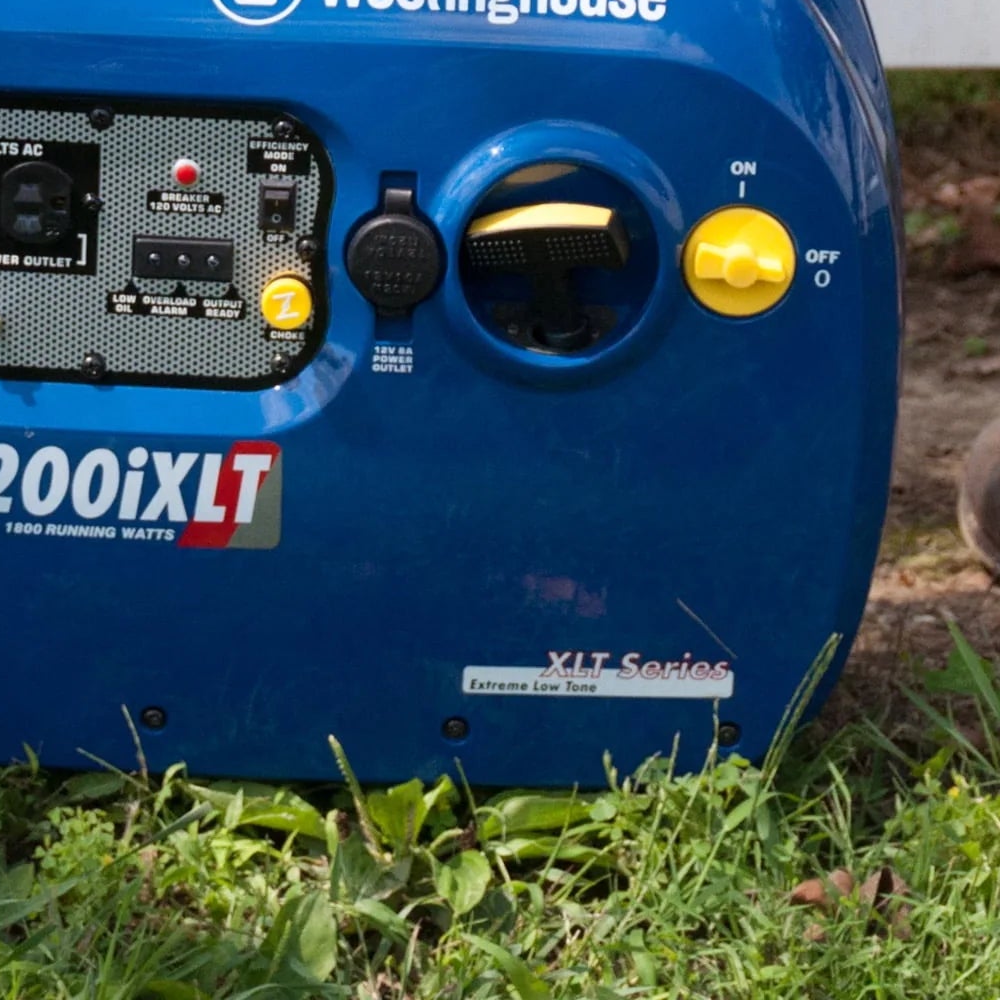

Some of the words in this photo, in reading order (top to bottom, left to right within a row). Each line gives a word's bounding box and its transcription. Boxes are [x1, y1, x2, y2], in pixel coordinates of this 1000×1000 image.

[22, 143, 44, 157] AC
[249, 140, 309, 151] EFFICIENCY
[263, 150, 295, 160] MODE
[270, 163, 287, 172] ON
[730, 161, 758, 176] ON
[161, 192, 210, 203] BREAKER
[150, 202, 171, 211] 120
[172, 203, 205, 213] VOLTS
[207, 204, 222, 214] AC
[266, 233, 285, 243] OFF
[23, 255, 73, 268] OUTLET
[805, 249, 841, 265] OFF
[112, 294, 137, 304] LOW
[142, 295, 197, 307] OVERLOAD
[203, 299, 243, 309] OUTPUT
[115, 303, 133, 313] OIL
[151, 305, 188, 315] ALARM
[205, 308, 241, 318] READY
[270, 330, 305, 340] CHOKE
[372, 354, 413, 364] POWER
[371, 363, 414, 373] OUTLET
[5, 522, 43, 536] 1800
[45, 524, 117, 540] RUNNING
[121, 527, 175, 542] WATTS
[541, 650, 611, 679] XLT
[617, 651, 731, 681] Series
[469, 679, 529, 692] Extreme
[532, 680, 561, 692] Low
[565, 681, 598, 694] Tone
